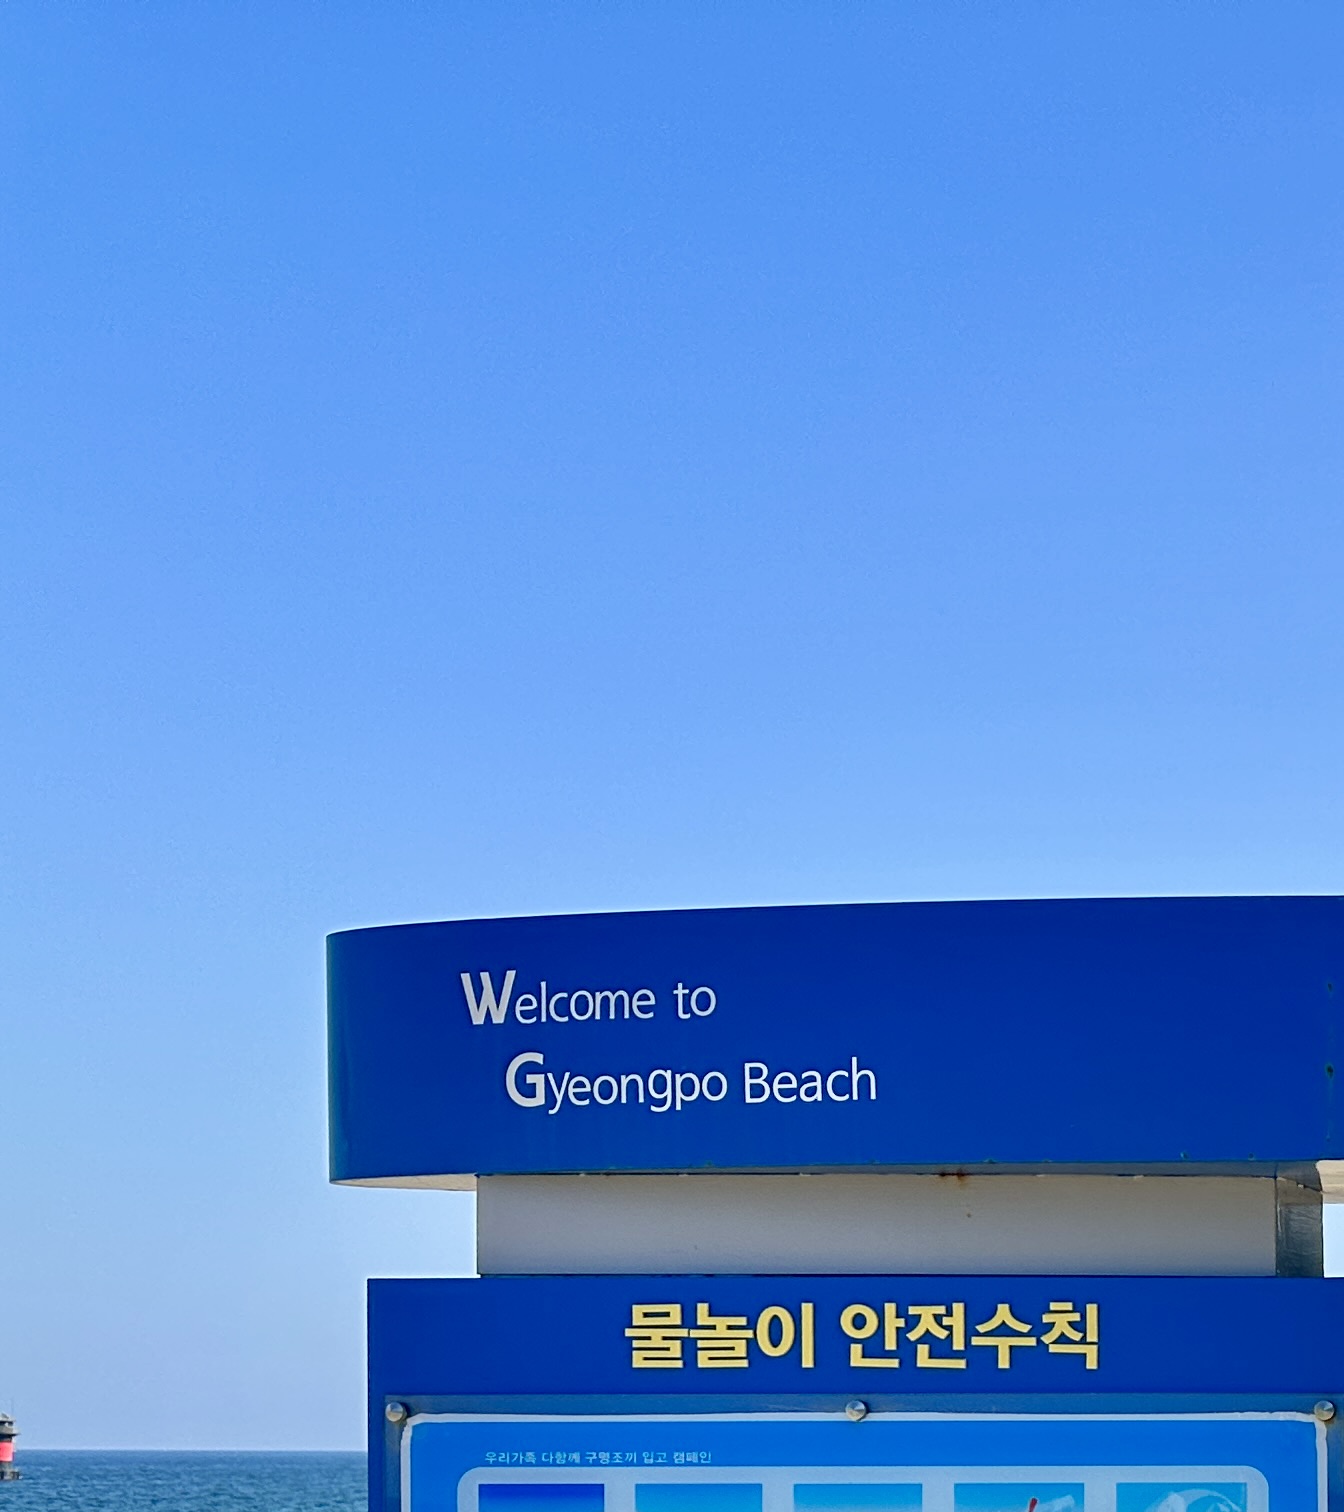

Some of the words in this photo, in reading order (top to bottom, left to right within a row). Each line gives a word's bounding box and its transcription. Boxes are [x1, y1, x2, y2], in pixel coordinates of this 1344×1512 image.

[461, 969, 656, 1025] Welcome
[673, 981, 716, 1021] to
[505, 1051, 728, 1114] Gyeongpo
[743, 1056, 878, 1105] Beach
[625, 1302, 815, 1370] 물놀이
[840, 1301, 1100, 1370] 안전수칙
[485, 1451, 537, 1464] 우리가족
[541, 1451, 581, 1464] 다함께
[585, 1451, 637, 1464] 구명조끼
[673, 1451, 712, 1464] 캠페인
